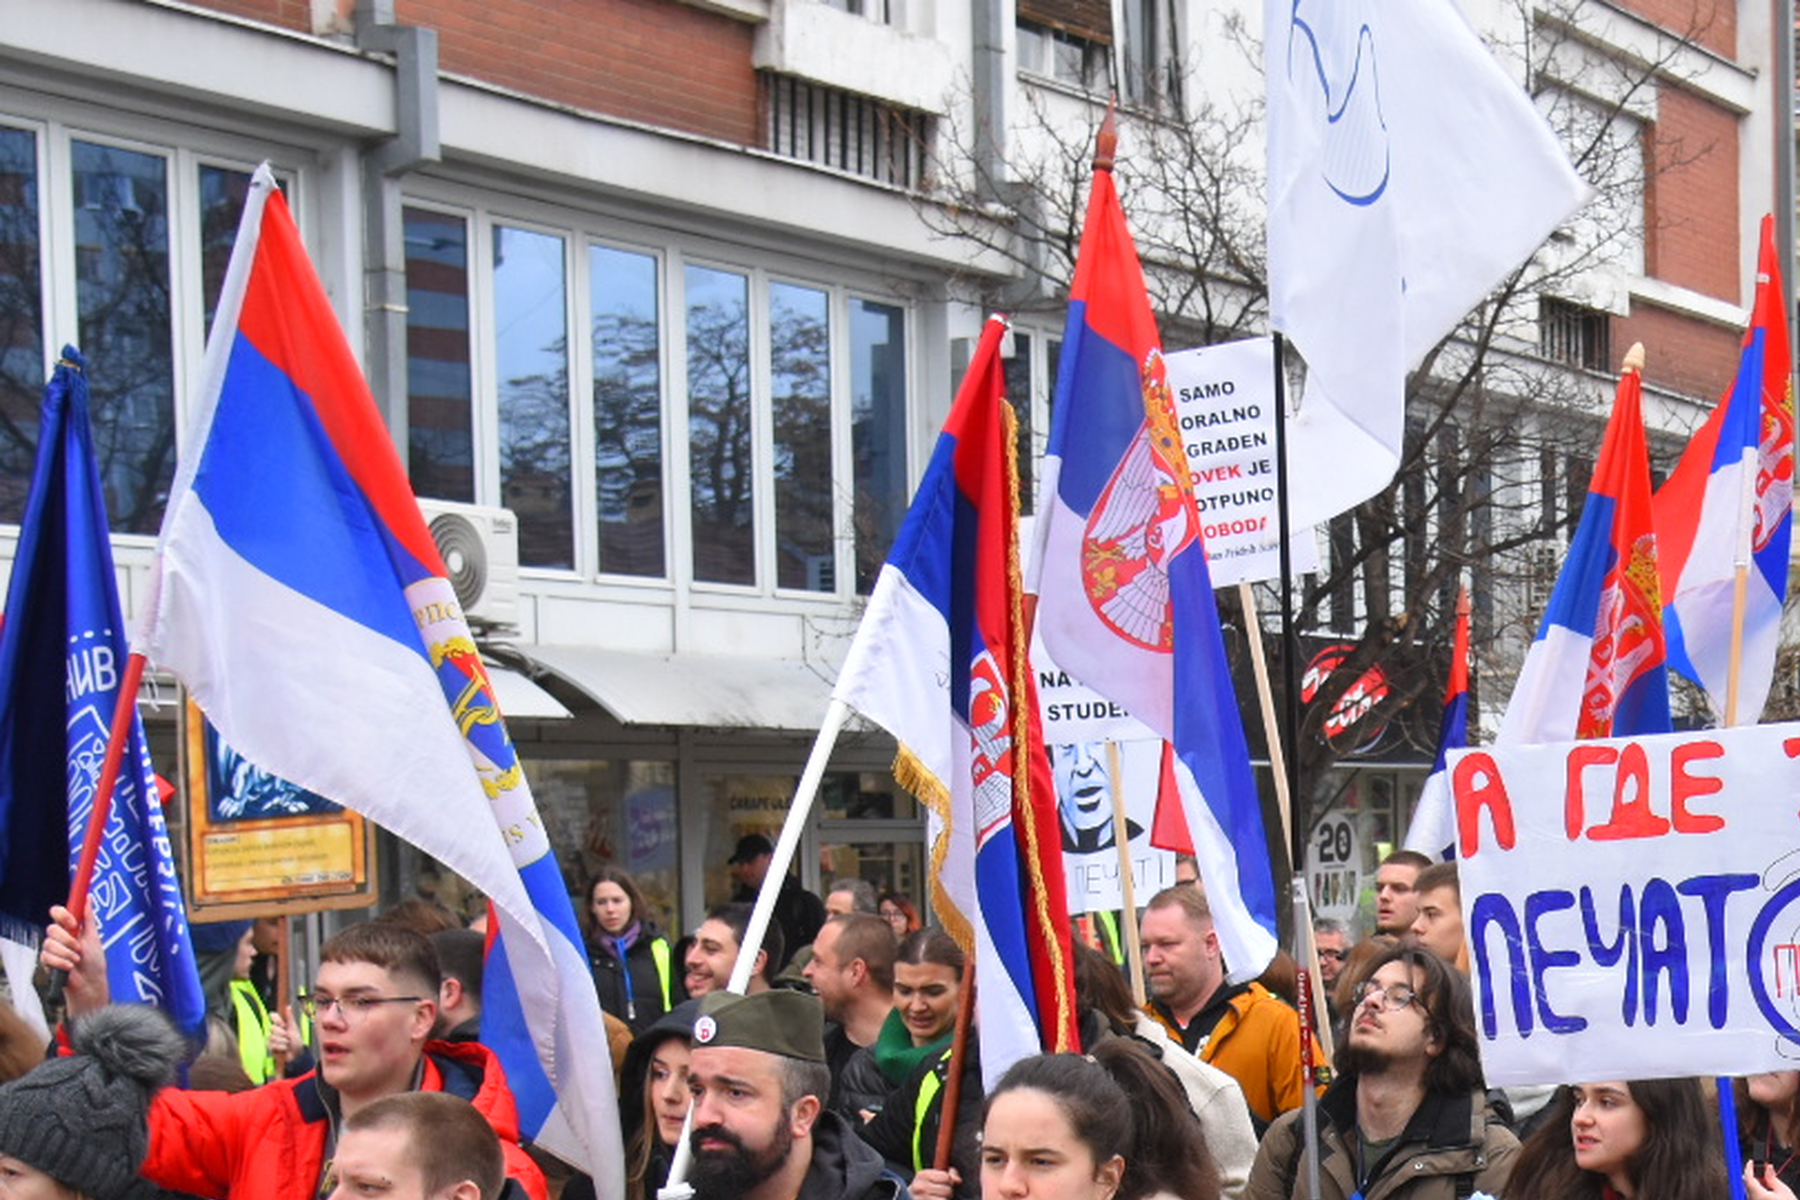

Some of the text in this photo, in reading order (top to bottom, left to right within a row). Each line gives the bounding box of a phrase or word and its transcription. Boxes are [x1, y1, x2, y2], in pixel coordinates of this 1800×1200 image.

[1180, 381, 1235, 403] SAMO
[1181, 405, 1261, 431] ORALNO
[1187, 432, 1268, 459] GRAĐEN
[1190, 459, 1272, 485] OVEK JE
[1196, 488, 1274, 512] OTPUNO
[1204, 517, 1267, 540] OBOD
[1040, 671, 1072, 688] NA
[1047, 702, 1129, 721] STUDE
[1453, 752, 1516, 858] А
[1564, 741, 1726, 841] ГДЕ
[1319, 822, 1352, 862] 20
[1471, 873, 1760, 1041] ПЕЧАТ
